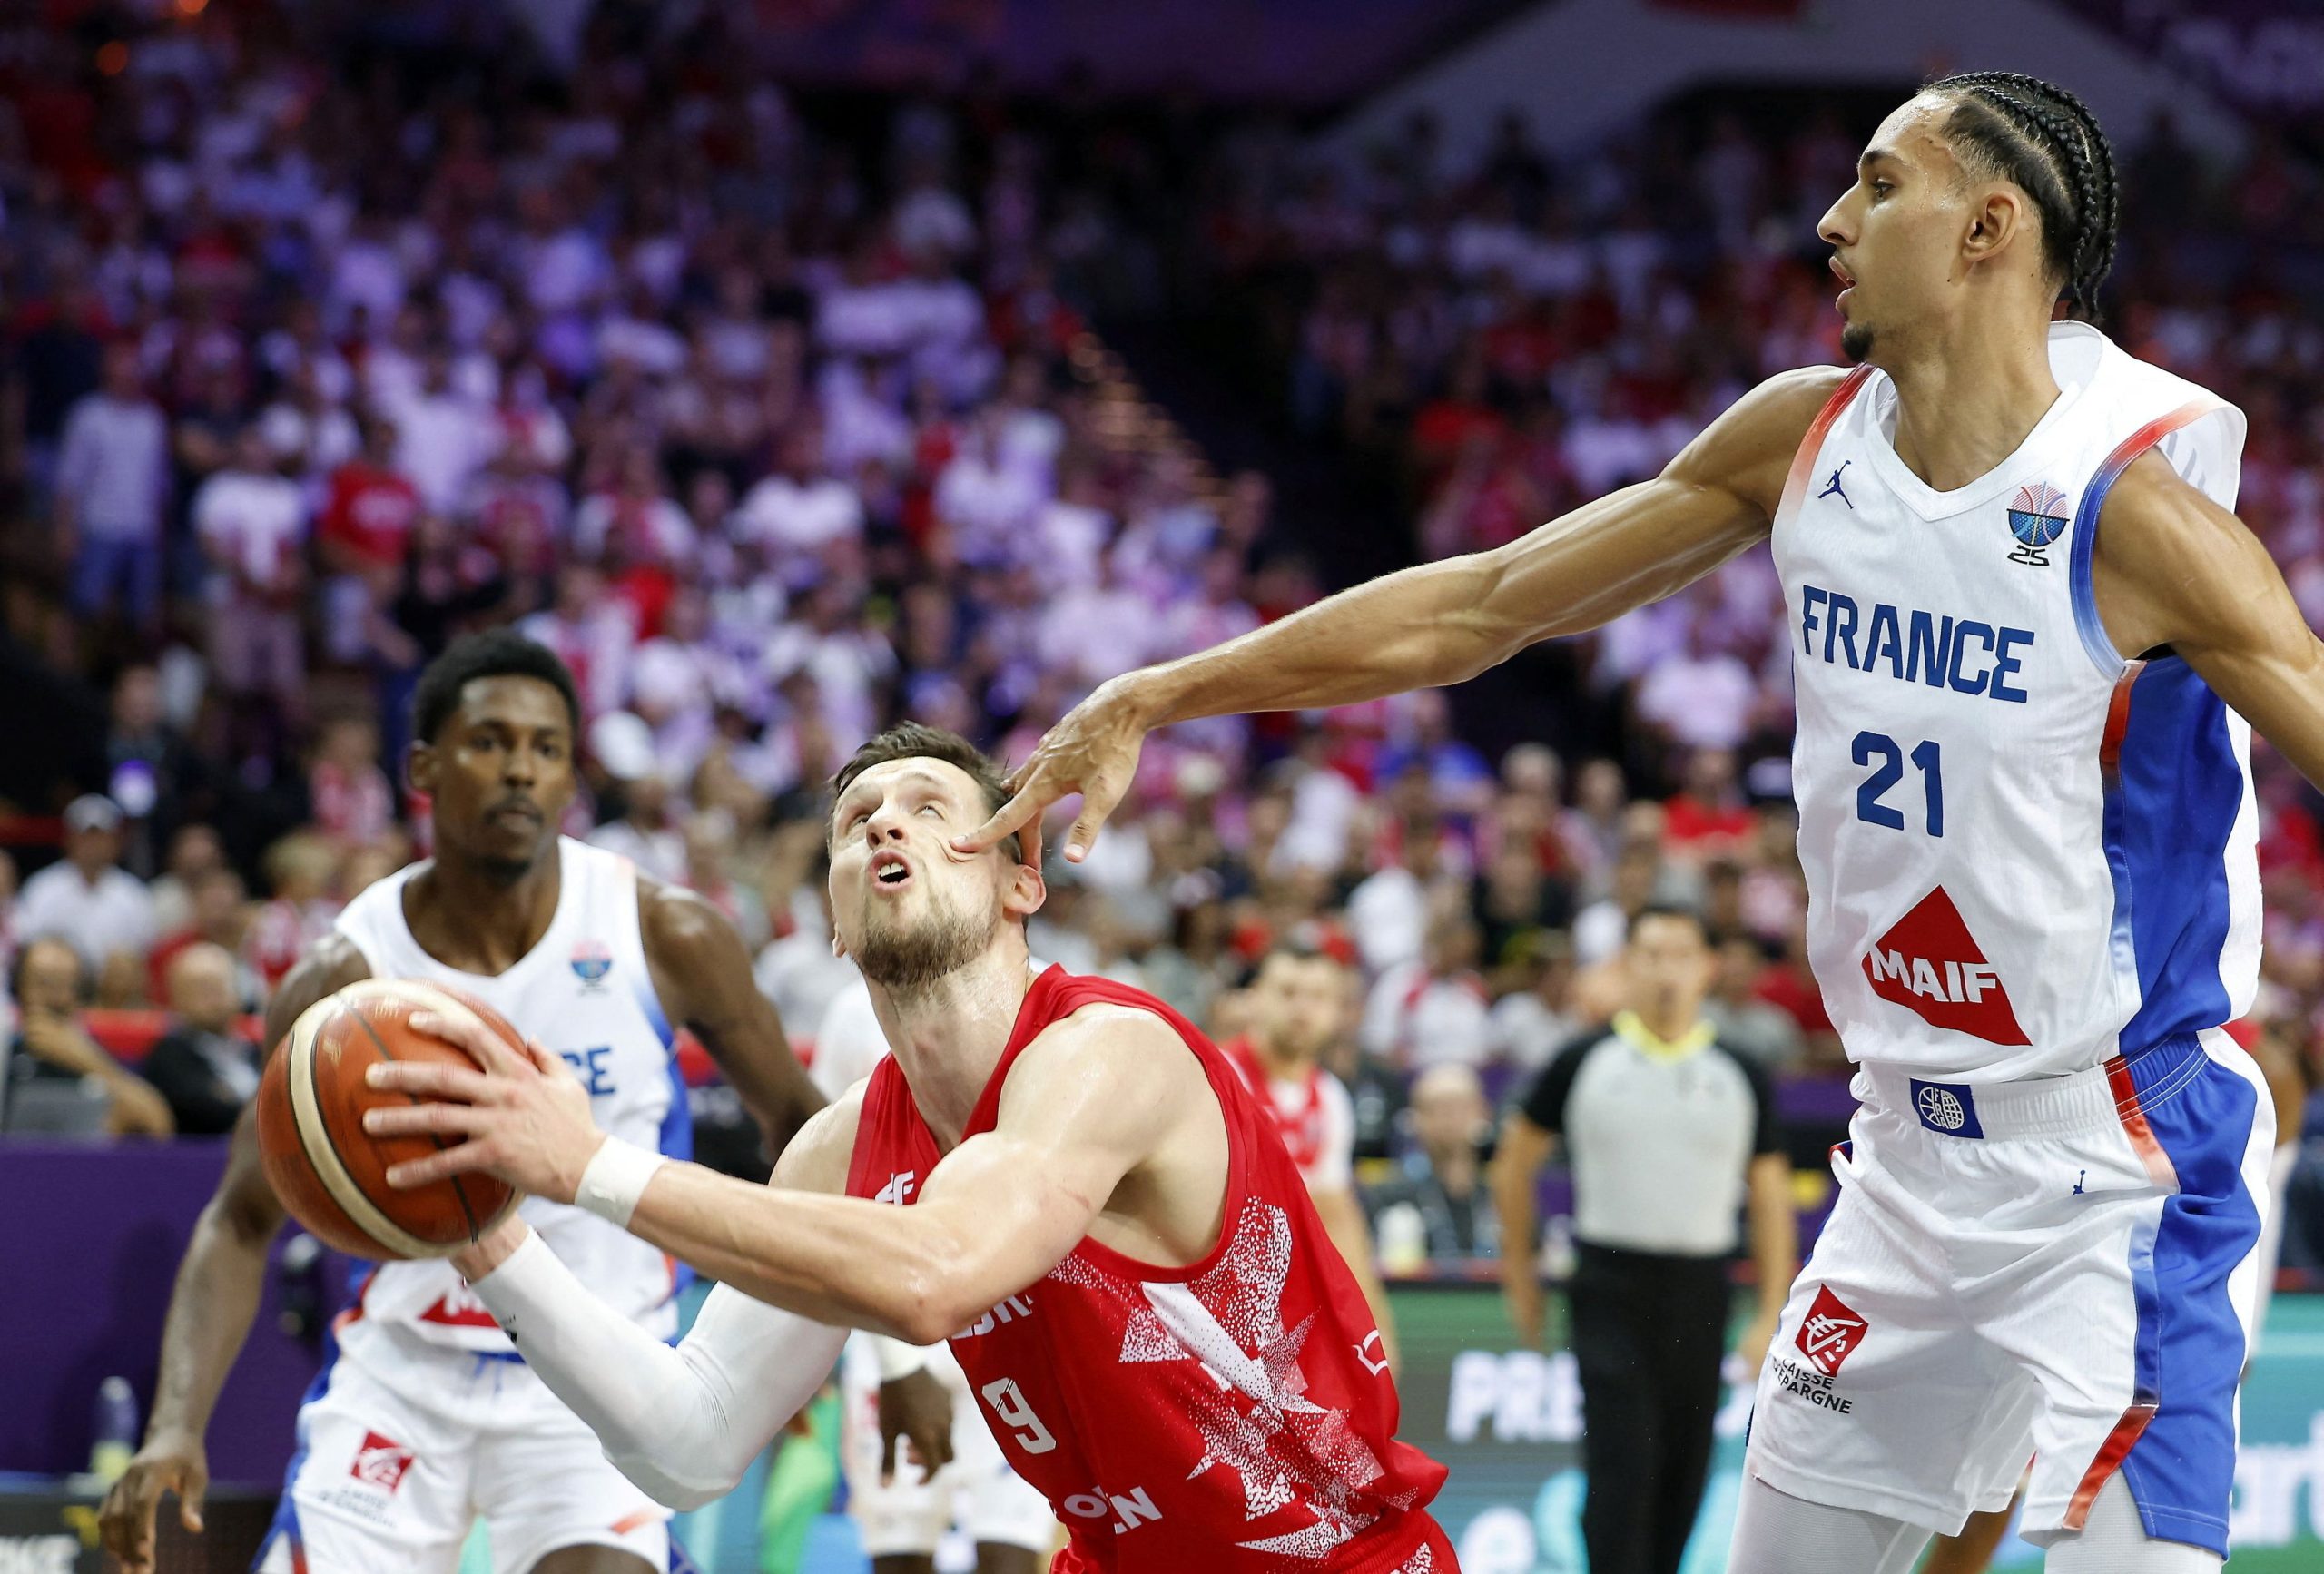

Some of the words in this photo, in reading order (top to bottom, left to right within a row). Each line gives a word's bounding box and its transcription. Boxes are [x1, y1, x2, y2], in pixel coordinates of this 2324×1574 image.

[1803, 584, 2035, 703] FRANCE
[1851, 730, 1944, 838] 21
[1869, 949, 1997, 1004] MAIF
[1782, 1358, 1835, 1390] CAISSE
[981, 1376, 1057, 1454] 9
